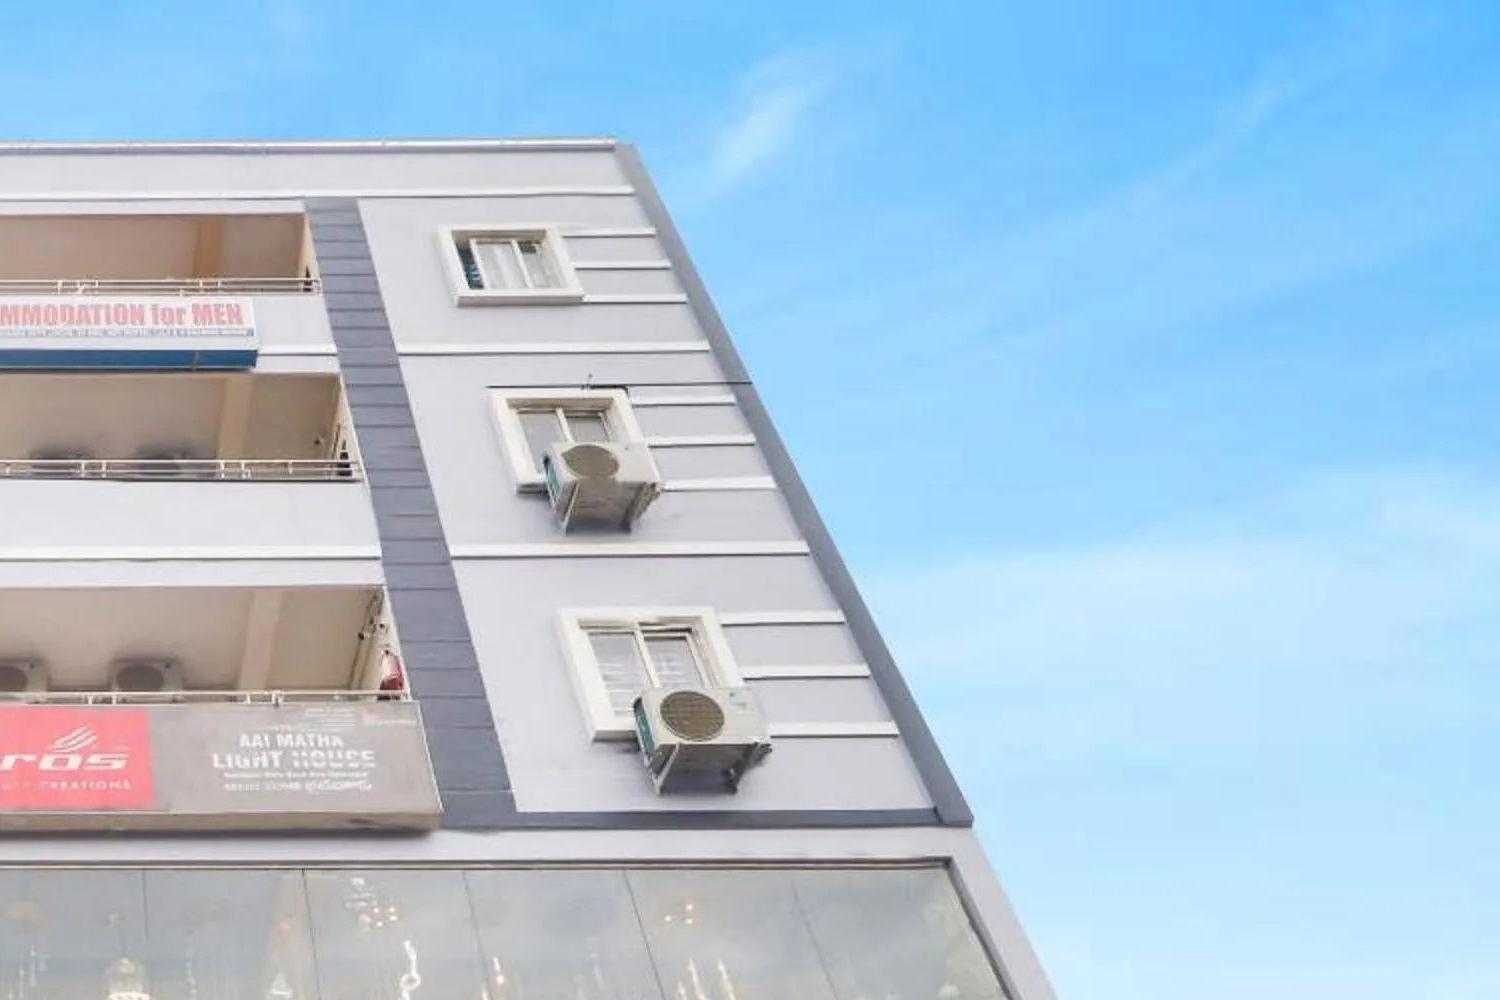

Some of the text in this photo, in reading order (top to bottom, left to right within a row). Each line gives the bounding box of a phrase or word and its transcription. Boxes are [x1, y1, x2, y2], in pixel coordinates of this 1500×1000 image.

[151, 304, 186, 326] for
[191, 304, 243, 326] MEN
[239, 733, 345, 749] AAI MATHA
[212, 750, 283, 769] LIGHT
